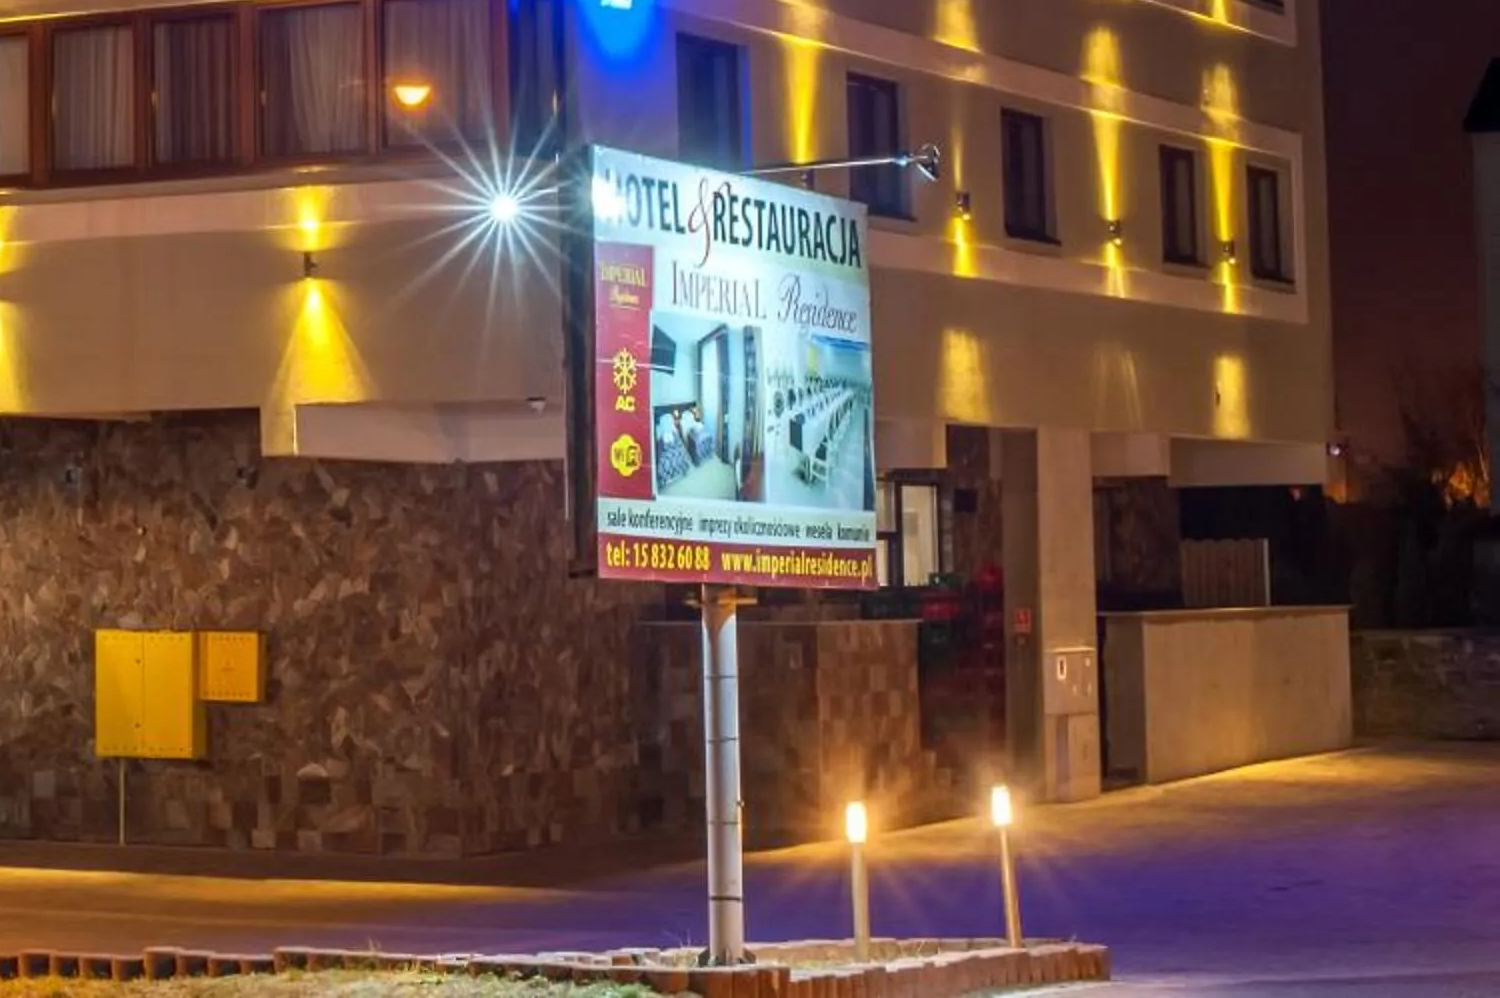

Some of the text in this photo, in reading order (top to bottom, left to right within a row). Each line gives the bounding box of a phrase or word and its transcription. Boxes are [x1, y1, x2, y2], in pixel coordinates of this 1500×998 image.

[712, 190, 862, 269] RESTAURACJA
[671, 260, 858, 333] IMPERIAL Residence
[615, 395, 636, 412] AC
[607, 507, 627, 527] sale
[628, 508, 693, 535] konferencyjne
[606, 540, 873, 586] tel: 15 832 60 88 www.imperialresidence.pl
